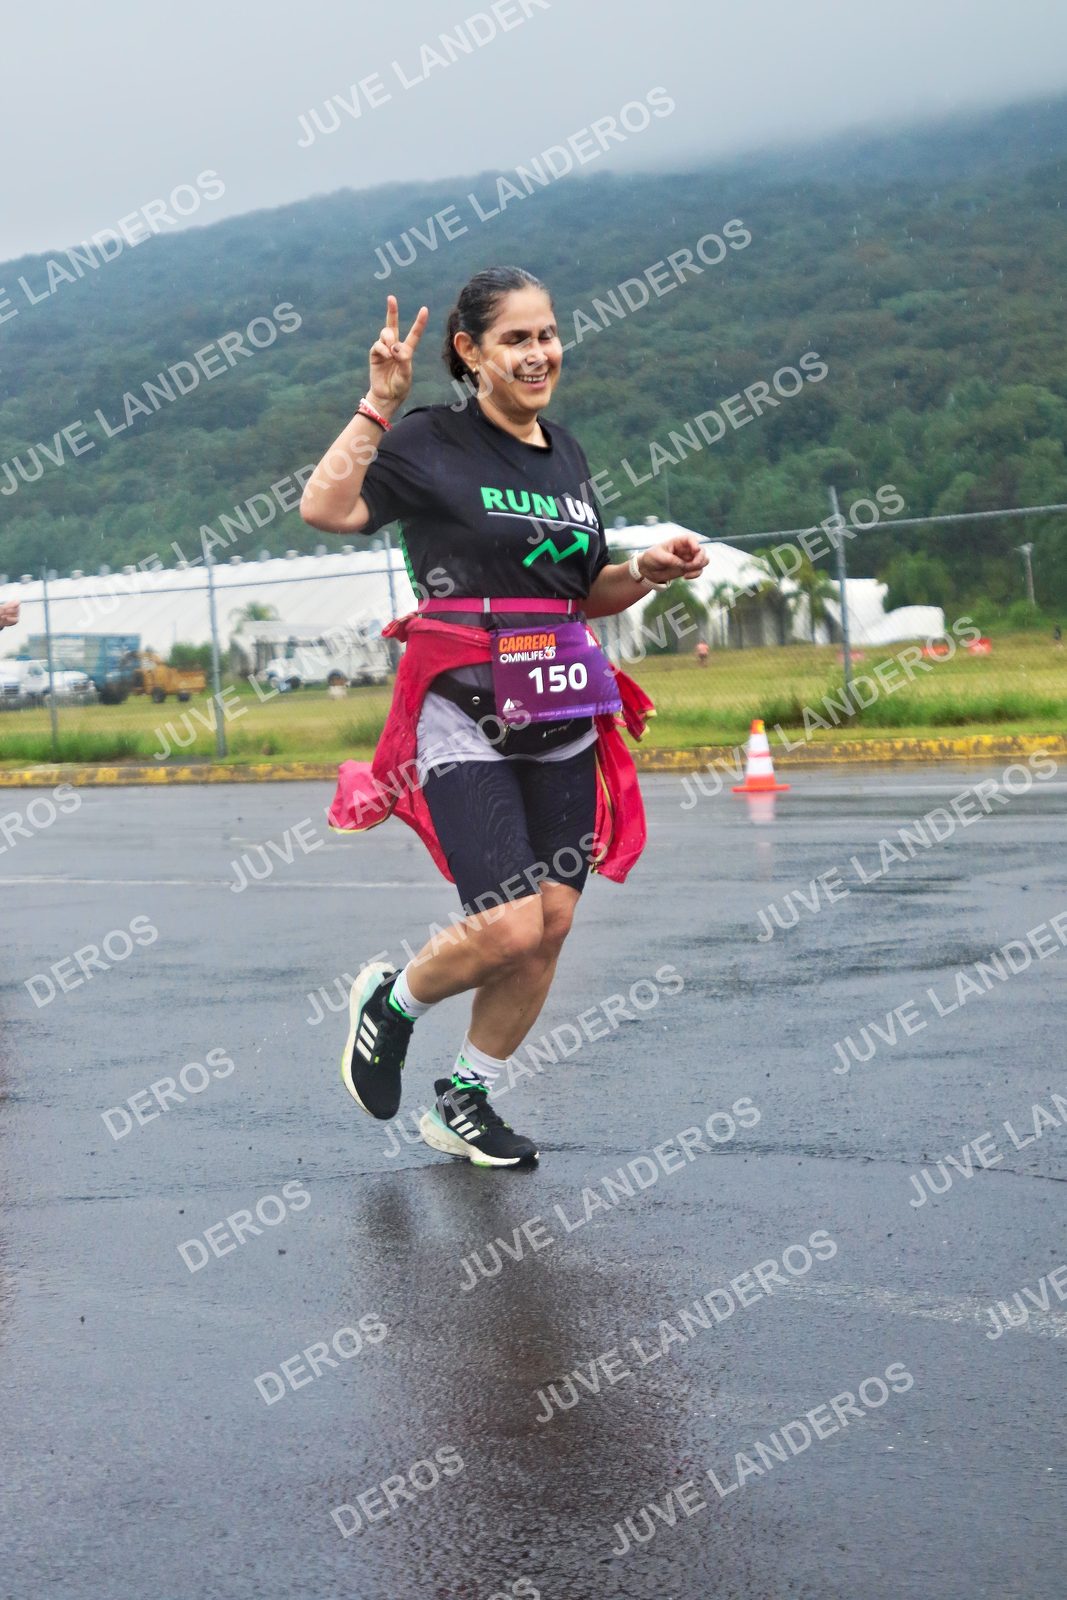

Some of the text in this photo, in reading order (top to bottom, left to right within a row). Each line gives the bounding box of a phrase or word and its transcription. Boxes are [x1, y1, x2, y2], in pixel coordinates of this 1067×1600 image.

[480, 486, 559, 518] RUN
[498, 633, 556, 654] CARRERA
[528, 662, 588, 694] 150
